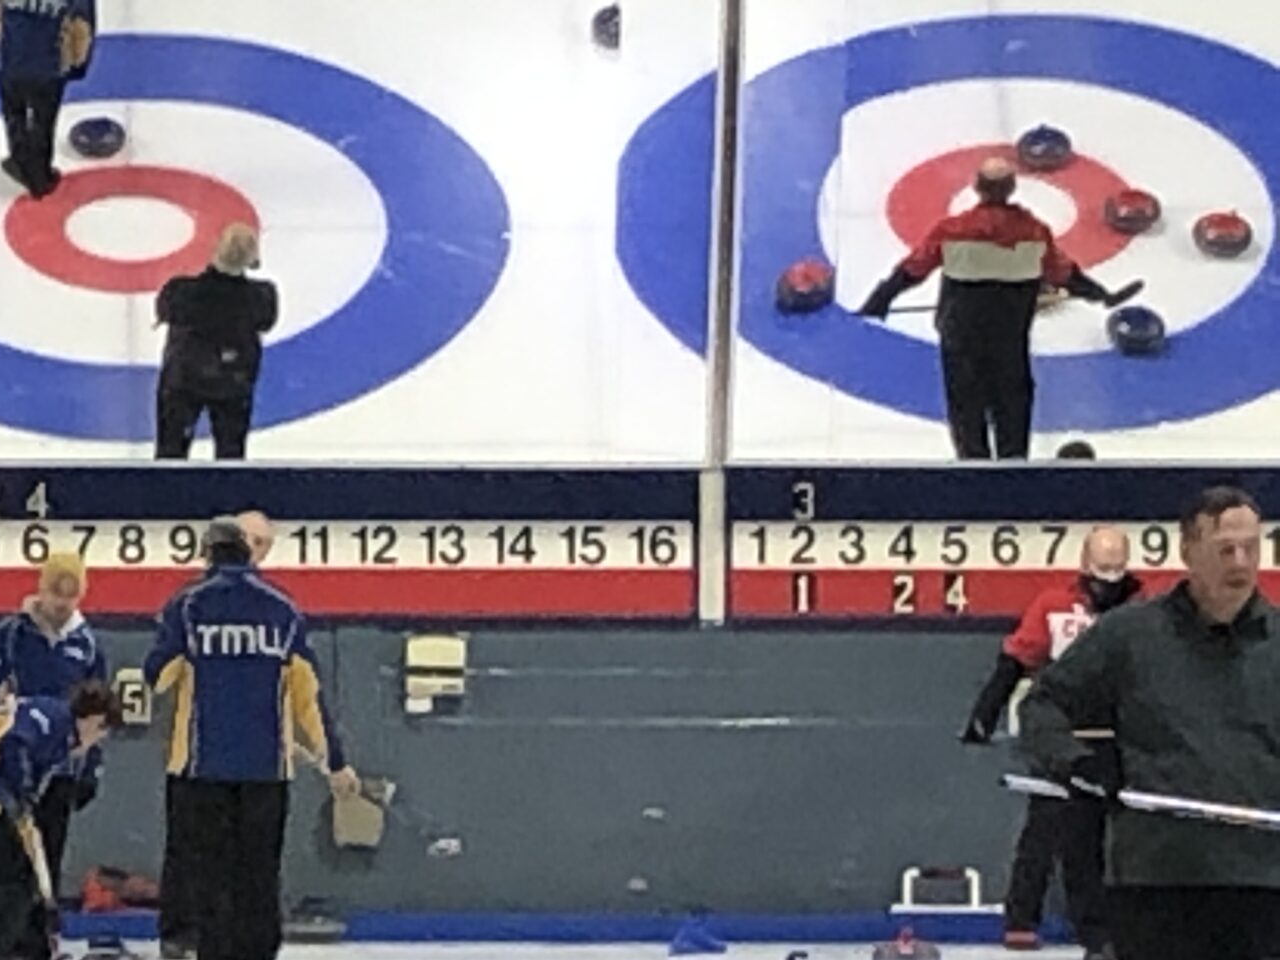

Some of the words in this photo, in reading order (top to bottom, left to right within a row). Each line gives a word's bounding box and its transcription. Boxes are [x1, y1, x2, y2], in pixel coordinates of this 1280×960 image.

[25, 481, 49, 518] 4
[793, 481, 815, 521] 3
[23, 524, 50, 564] 6
[72, 525, 97, 560] 7
[119, 524, 146, 564] 8
[169, 524, 197, 564] 9
[291, 525, 329, 564] 11
[352, 524, 397, 564] 12
[420, 525, 466, 564] 13
[489, 525, 536, 564] 14
[560, 525, 606, 564] 15
[630, 525, 677, 564] 16
[750, 525, 766, 564] 1
[791, 524, 816, 564] 2
[839, 524, 866, 565] 3
[889, 524, 916, 564] 4
[941, 524, 968, 565] 5
[992, 524, 1020, 566] 6
[1041, 525, 1068, 565] 7
[1141, 524, 1169, 567] 9
[795, 574, 809, 613] 1
[892, 575, 914, 613] 2
[946, 575, 968, 613] 4
[196, 623, 292, 659] TMU
